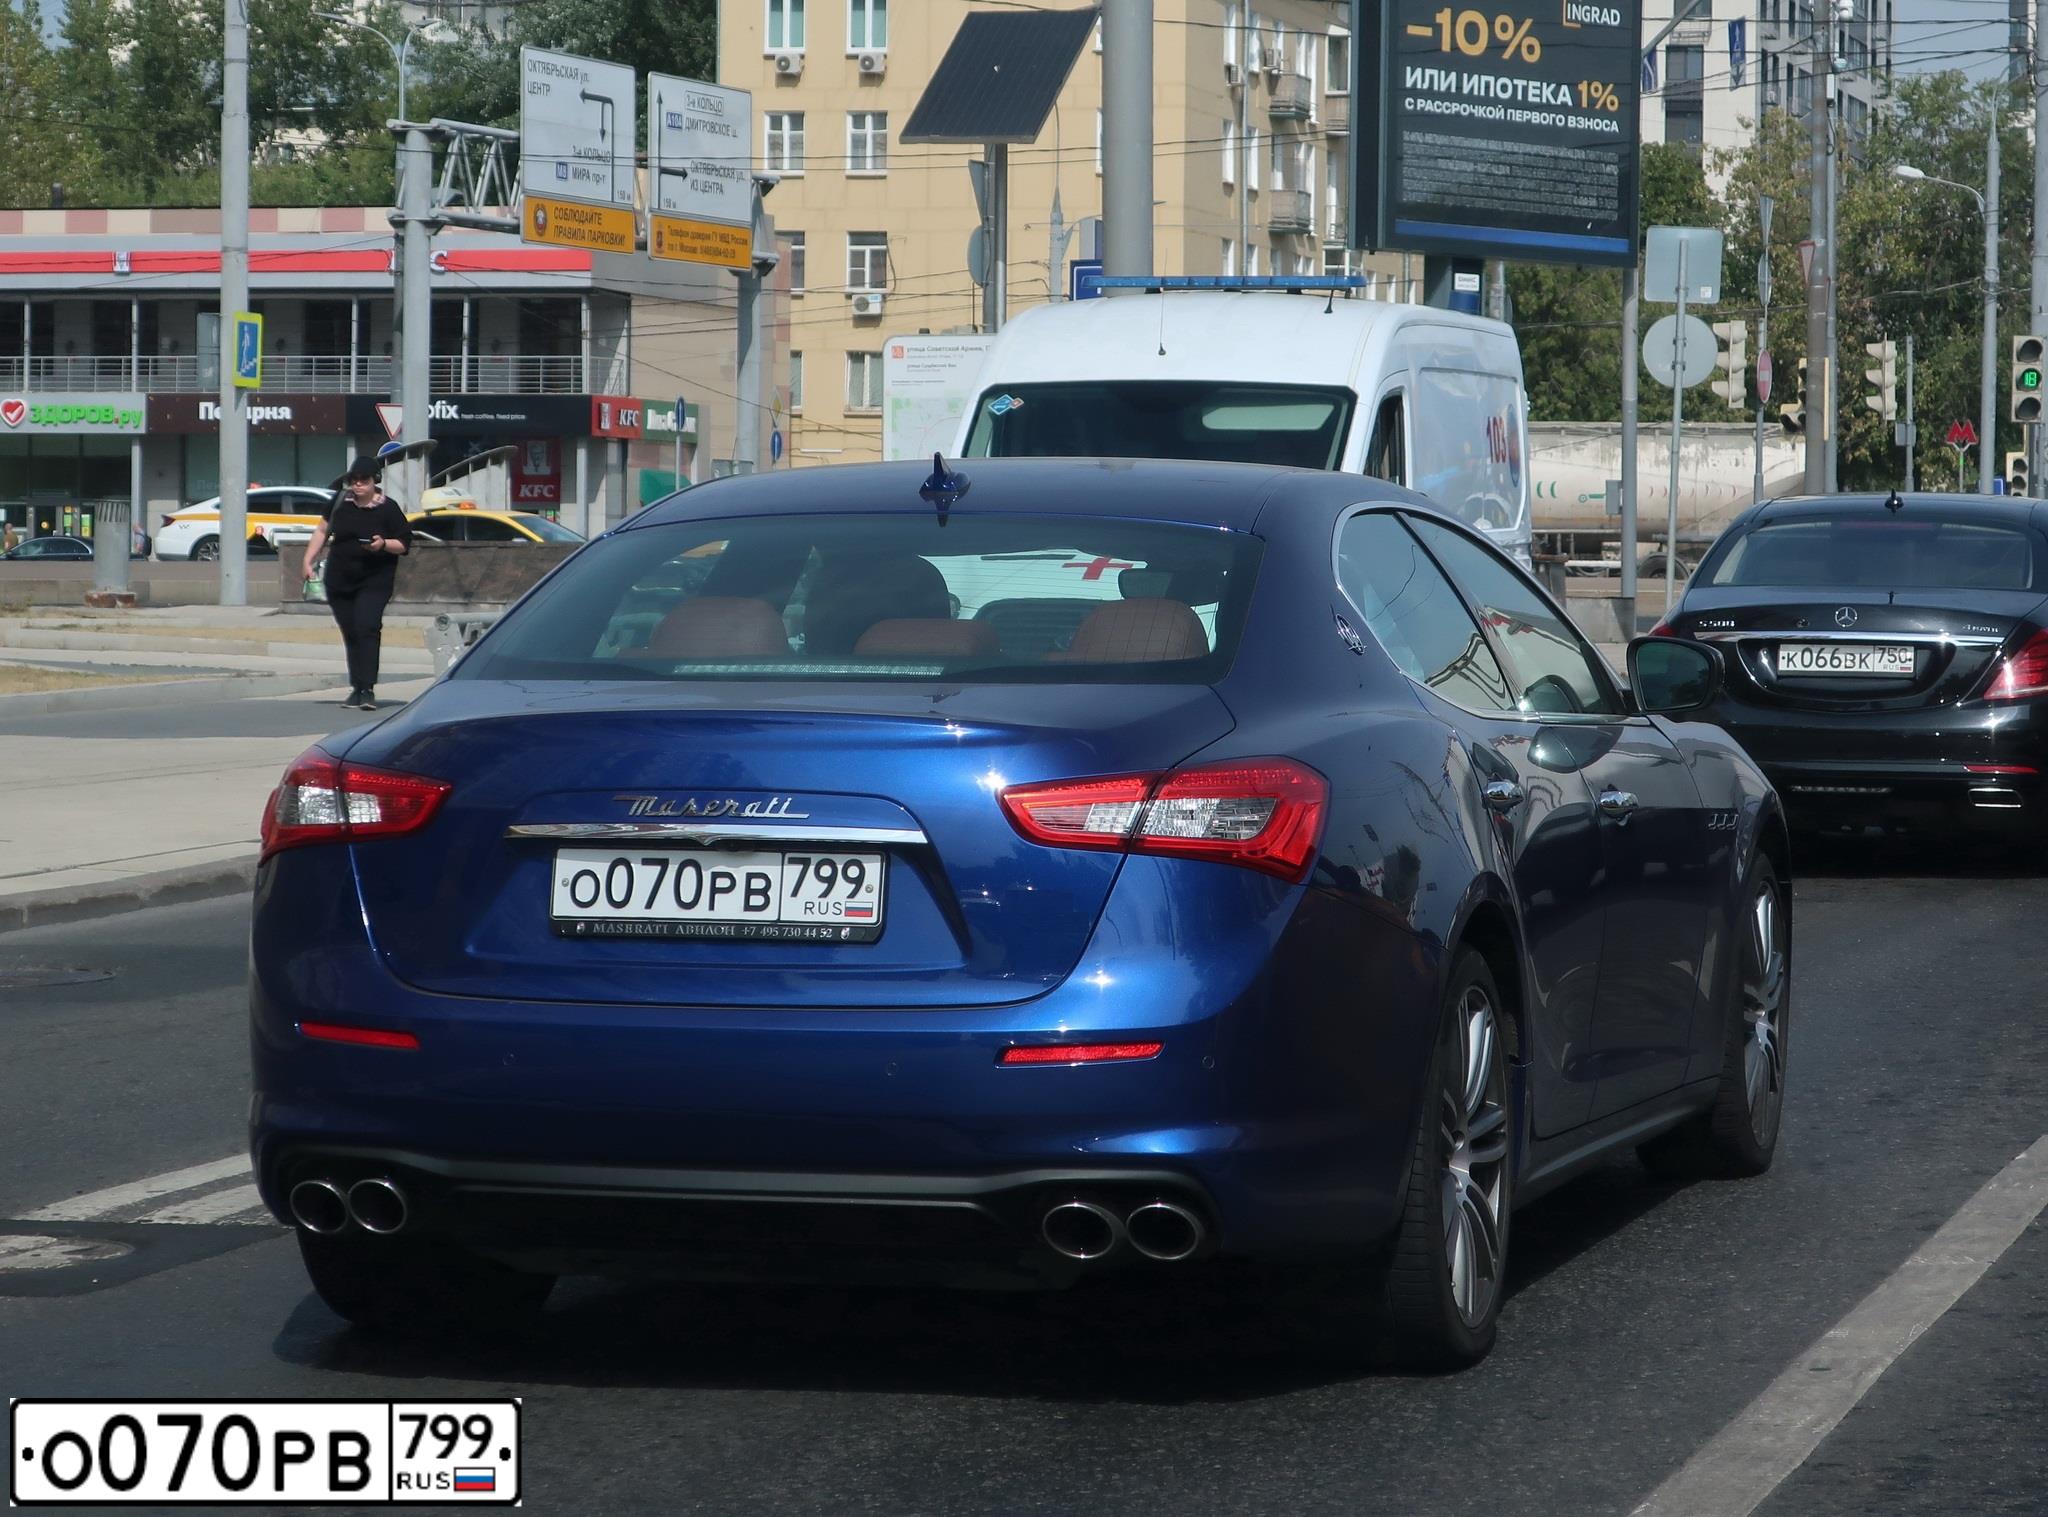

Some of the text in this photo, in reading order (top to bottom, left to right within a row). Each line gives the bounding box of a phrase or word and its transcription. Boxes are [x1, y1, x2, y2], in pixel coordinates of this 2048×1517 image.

[1567, 3, 1621, 26] INGRAD
[527, 59, 590, 84] ОКТЯБРЬСКАЯ ул.
[527, 81, 551, 96] ЦЕНТР
[1405, 66, 1619, 111] ИЛИ ИПОТЕКА 1%
[697, 98, 723, 113] КОЛЬЦО
[1405, 98, 1619, 133] С РАССРОЧКОЙ ПЕРВОГО ВЗНОСА
[685, 117, 730, 136] ДМИТРОВСКОЕ
[583, 147, 611, 163] КОЛЬЦО
[572, 167, 606, 185] МИРА пр-т
[690, 160, 745, 182] ОКТЯБРЬСКАЯ ул.
[690, 180, 724, 195] ИЗ ЦЕНТРА
[553, 206, 602, 226] СОБЛЮДАЙТЕ
[553, 225, 625, 247] ПРАВИЛА ПАРКОВКИ!
[619, 408, 639, 427] KFC
[518, 484, 555, 498] KFC
[1786, 647, 1908, 670] К066ВК 750
[613, 796, 810, 819] Maserati
[569, 857, 866, 912] О070РВ 799
[804, 902, 842, 917] RUS
[593, 924, 833, 939] MASERATI АВИЛОН +7 495 730 44 52
